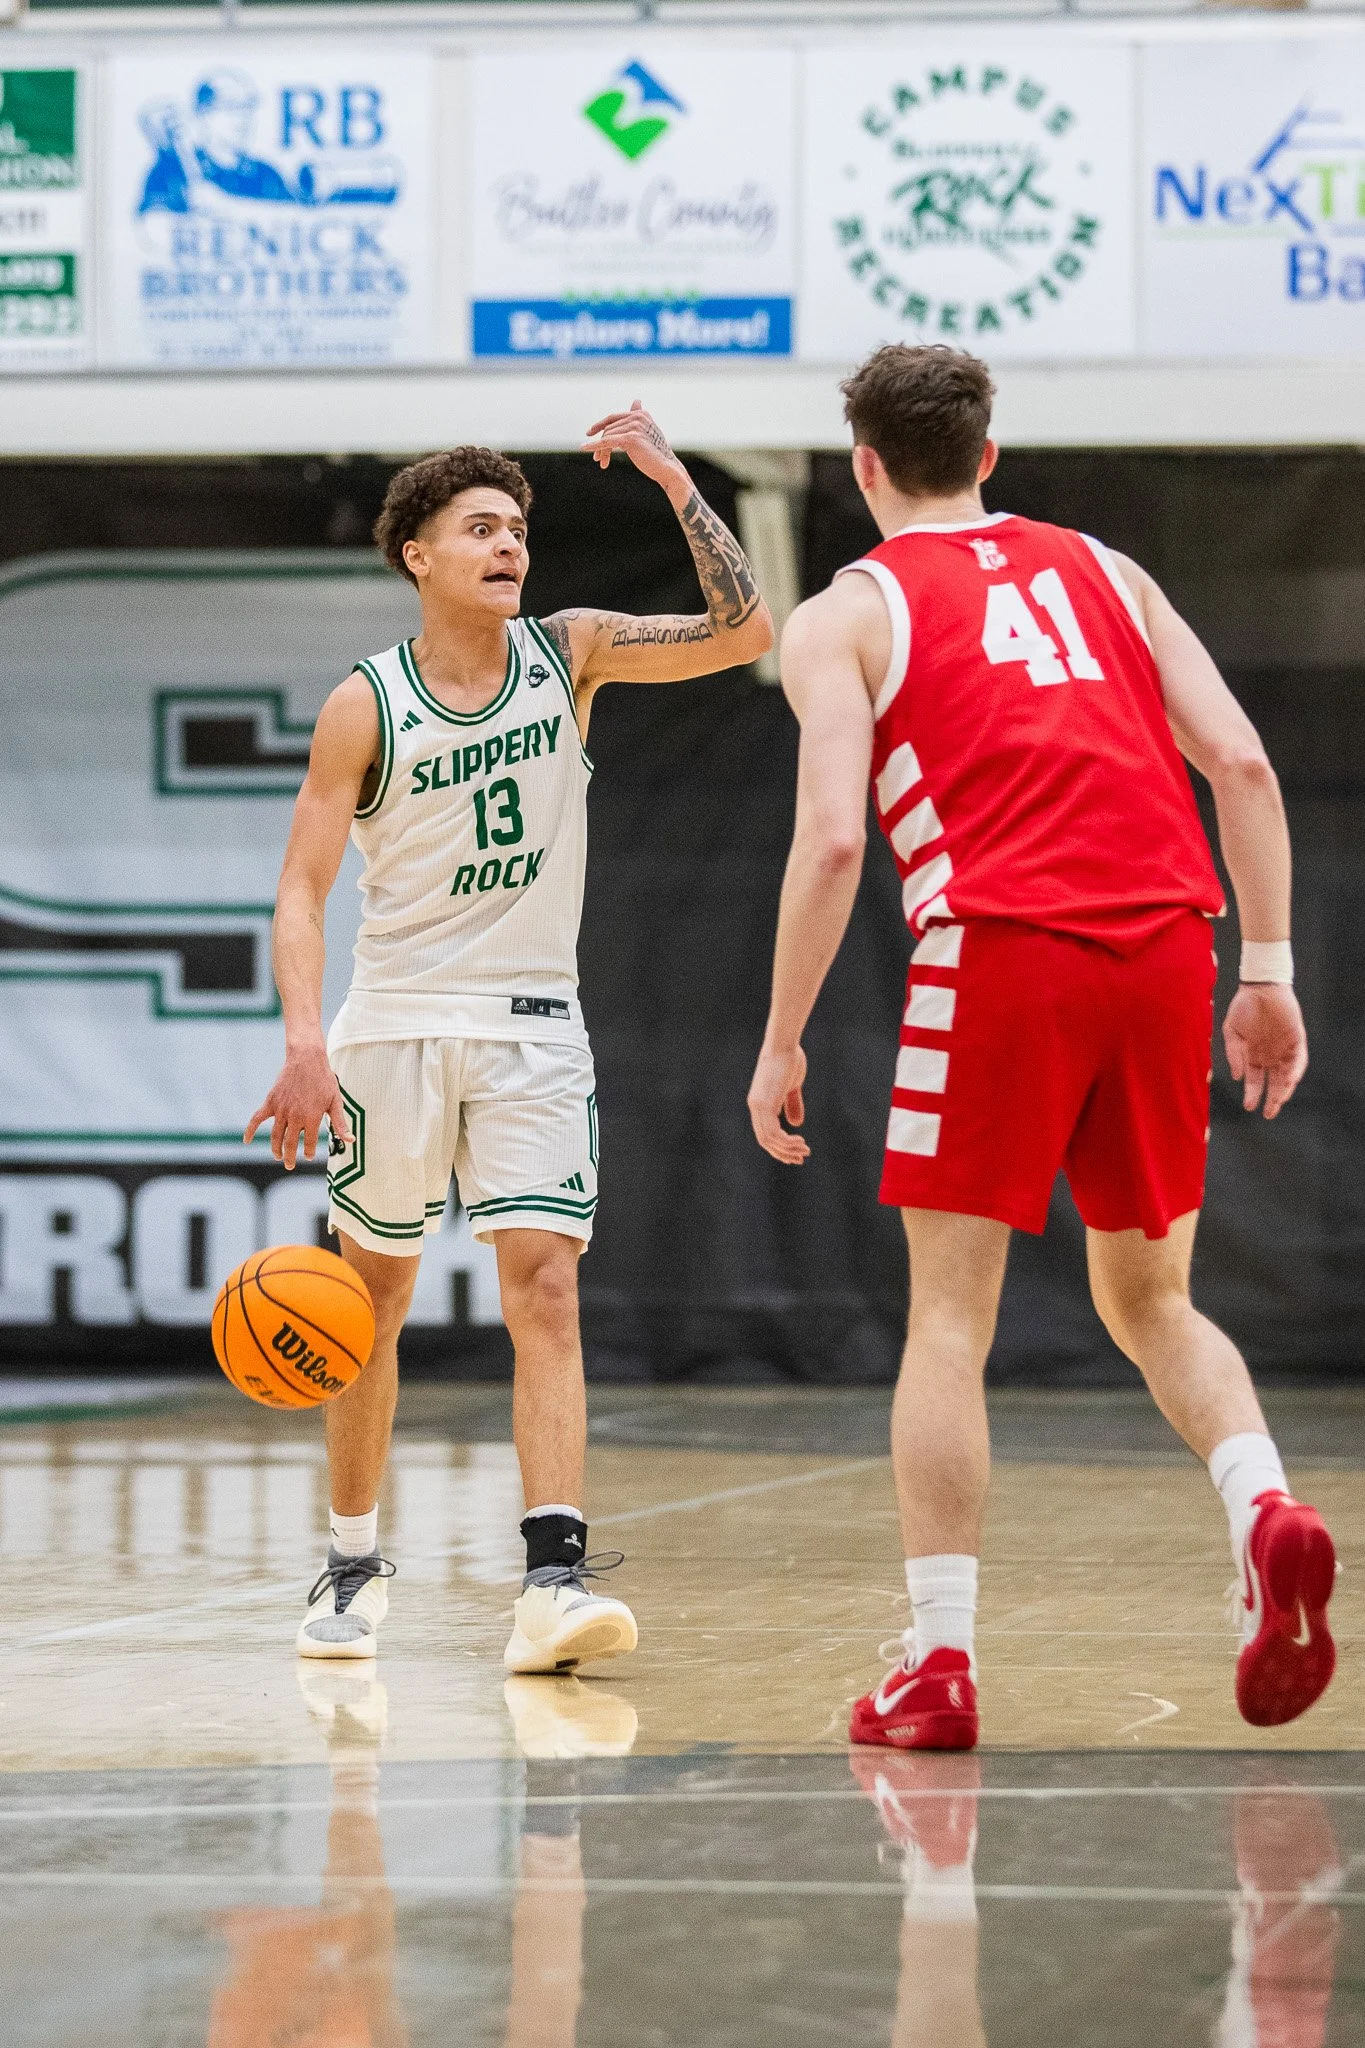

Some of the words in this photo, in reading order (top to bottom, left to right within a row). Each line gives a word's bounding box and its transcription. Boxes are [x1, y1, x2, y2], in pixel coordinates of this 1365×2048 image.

[279, 84, 388, 149] RB
[861, 63, 1077, 137] CAMPUS
[139, 267, 410, 300] BROTHERS
[833, 212, 1098, 335] RECREATION
[508, 308, 653, 359] Explore
[656, 308, 771, 349] More!
[612, 622, 714, 649] BLESSED
[981, 567, 1105, 687] 41
[410, 714, 563, 795] SLIPPERY
[473, 776, 525, 851] 13
[449, 847, 546, 897] ROCK
[271, 1320, 347, 1394] Wilson
